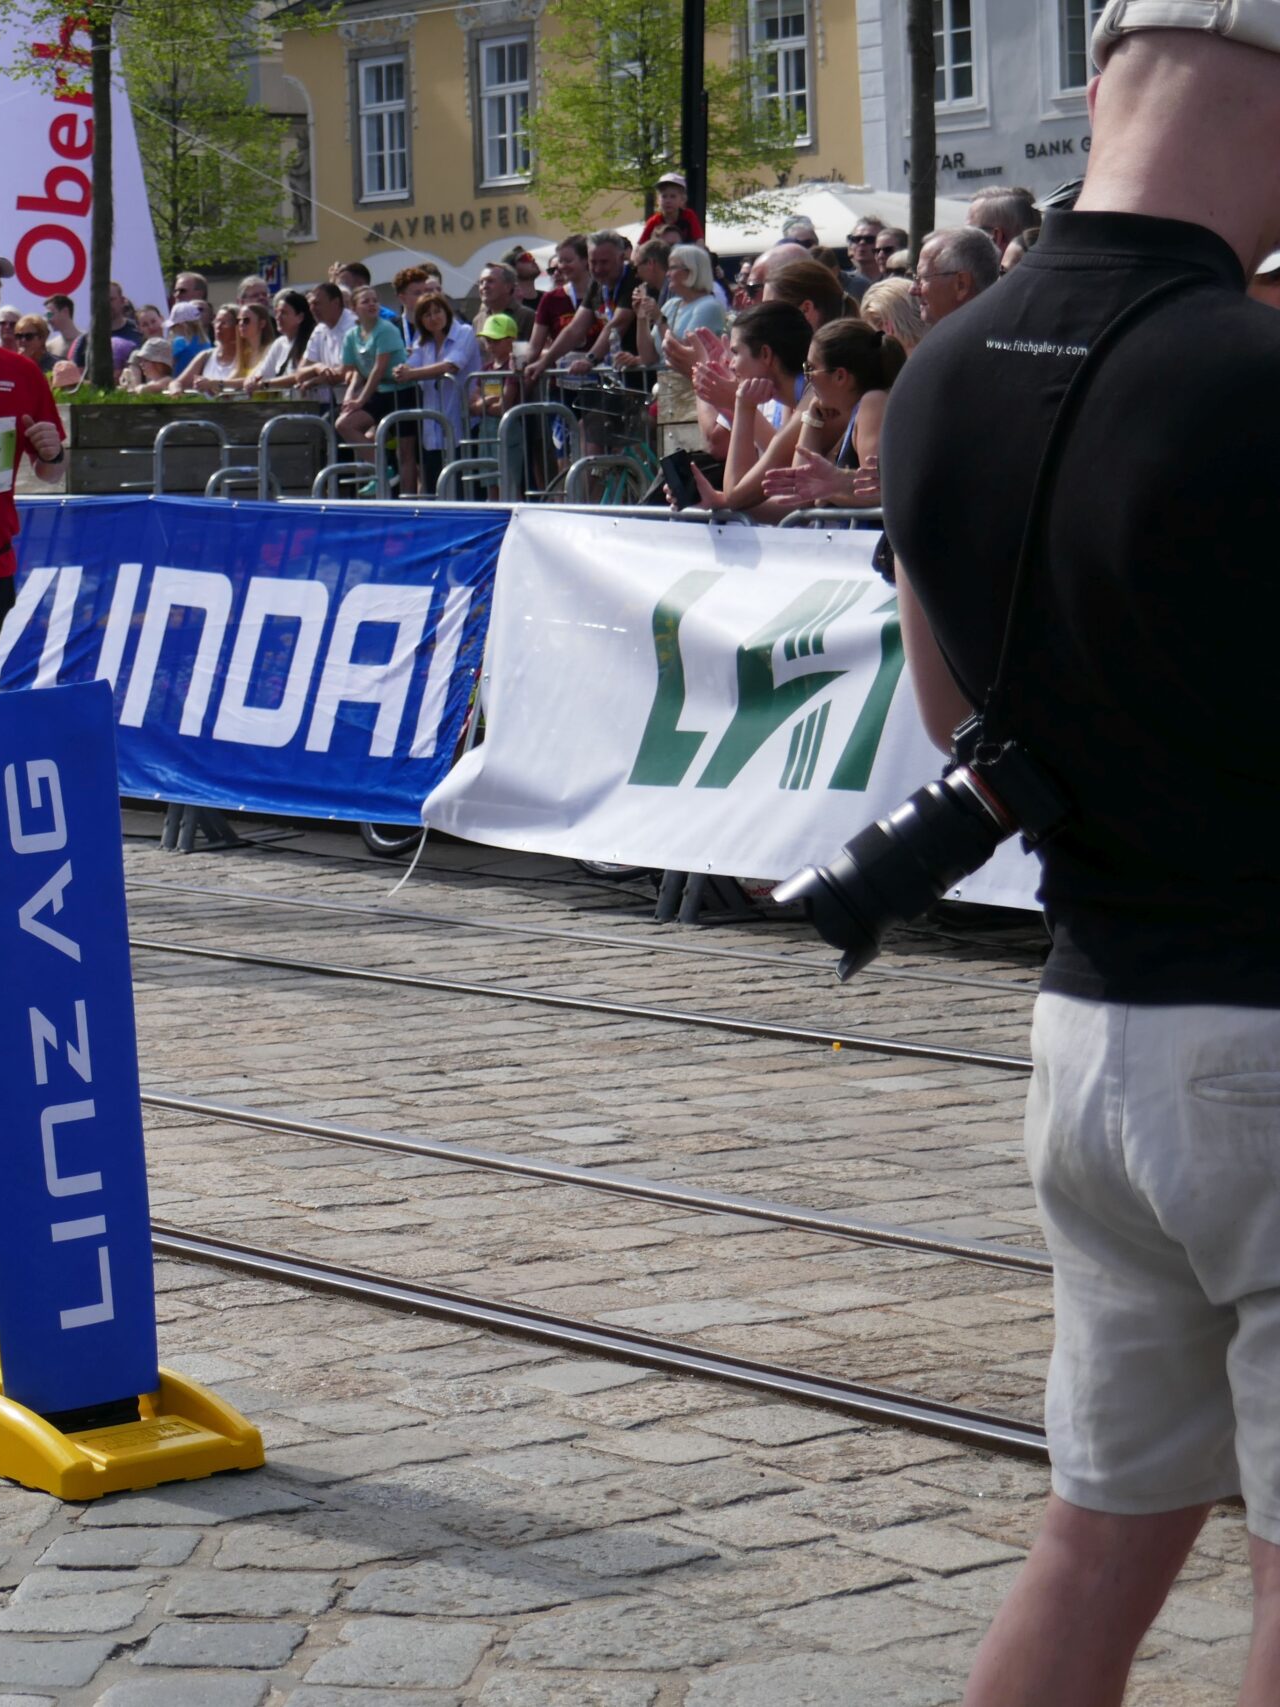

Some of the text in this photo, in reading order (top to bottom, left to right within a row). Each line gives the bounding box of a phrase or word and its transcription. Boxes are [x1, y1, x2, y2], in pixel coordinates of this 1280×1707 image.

[1025, 138, 1073, 159] BANK
[903, 152, 966, 176] NAR
[365, 205, 529, 242] MAYRHOFER
[985, 340, 1088, 357] www.fitchgallery.com
[4, 758, 115, 1330] LINZ AG
